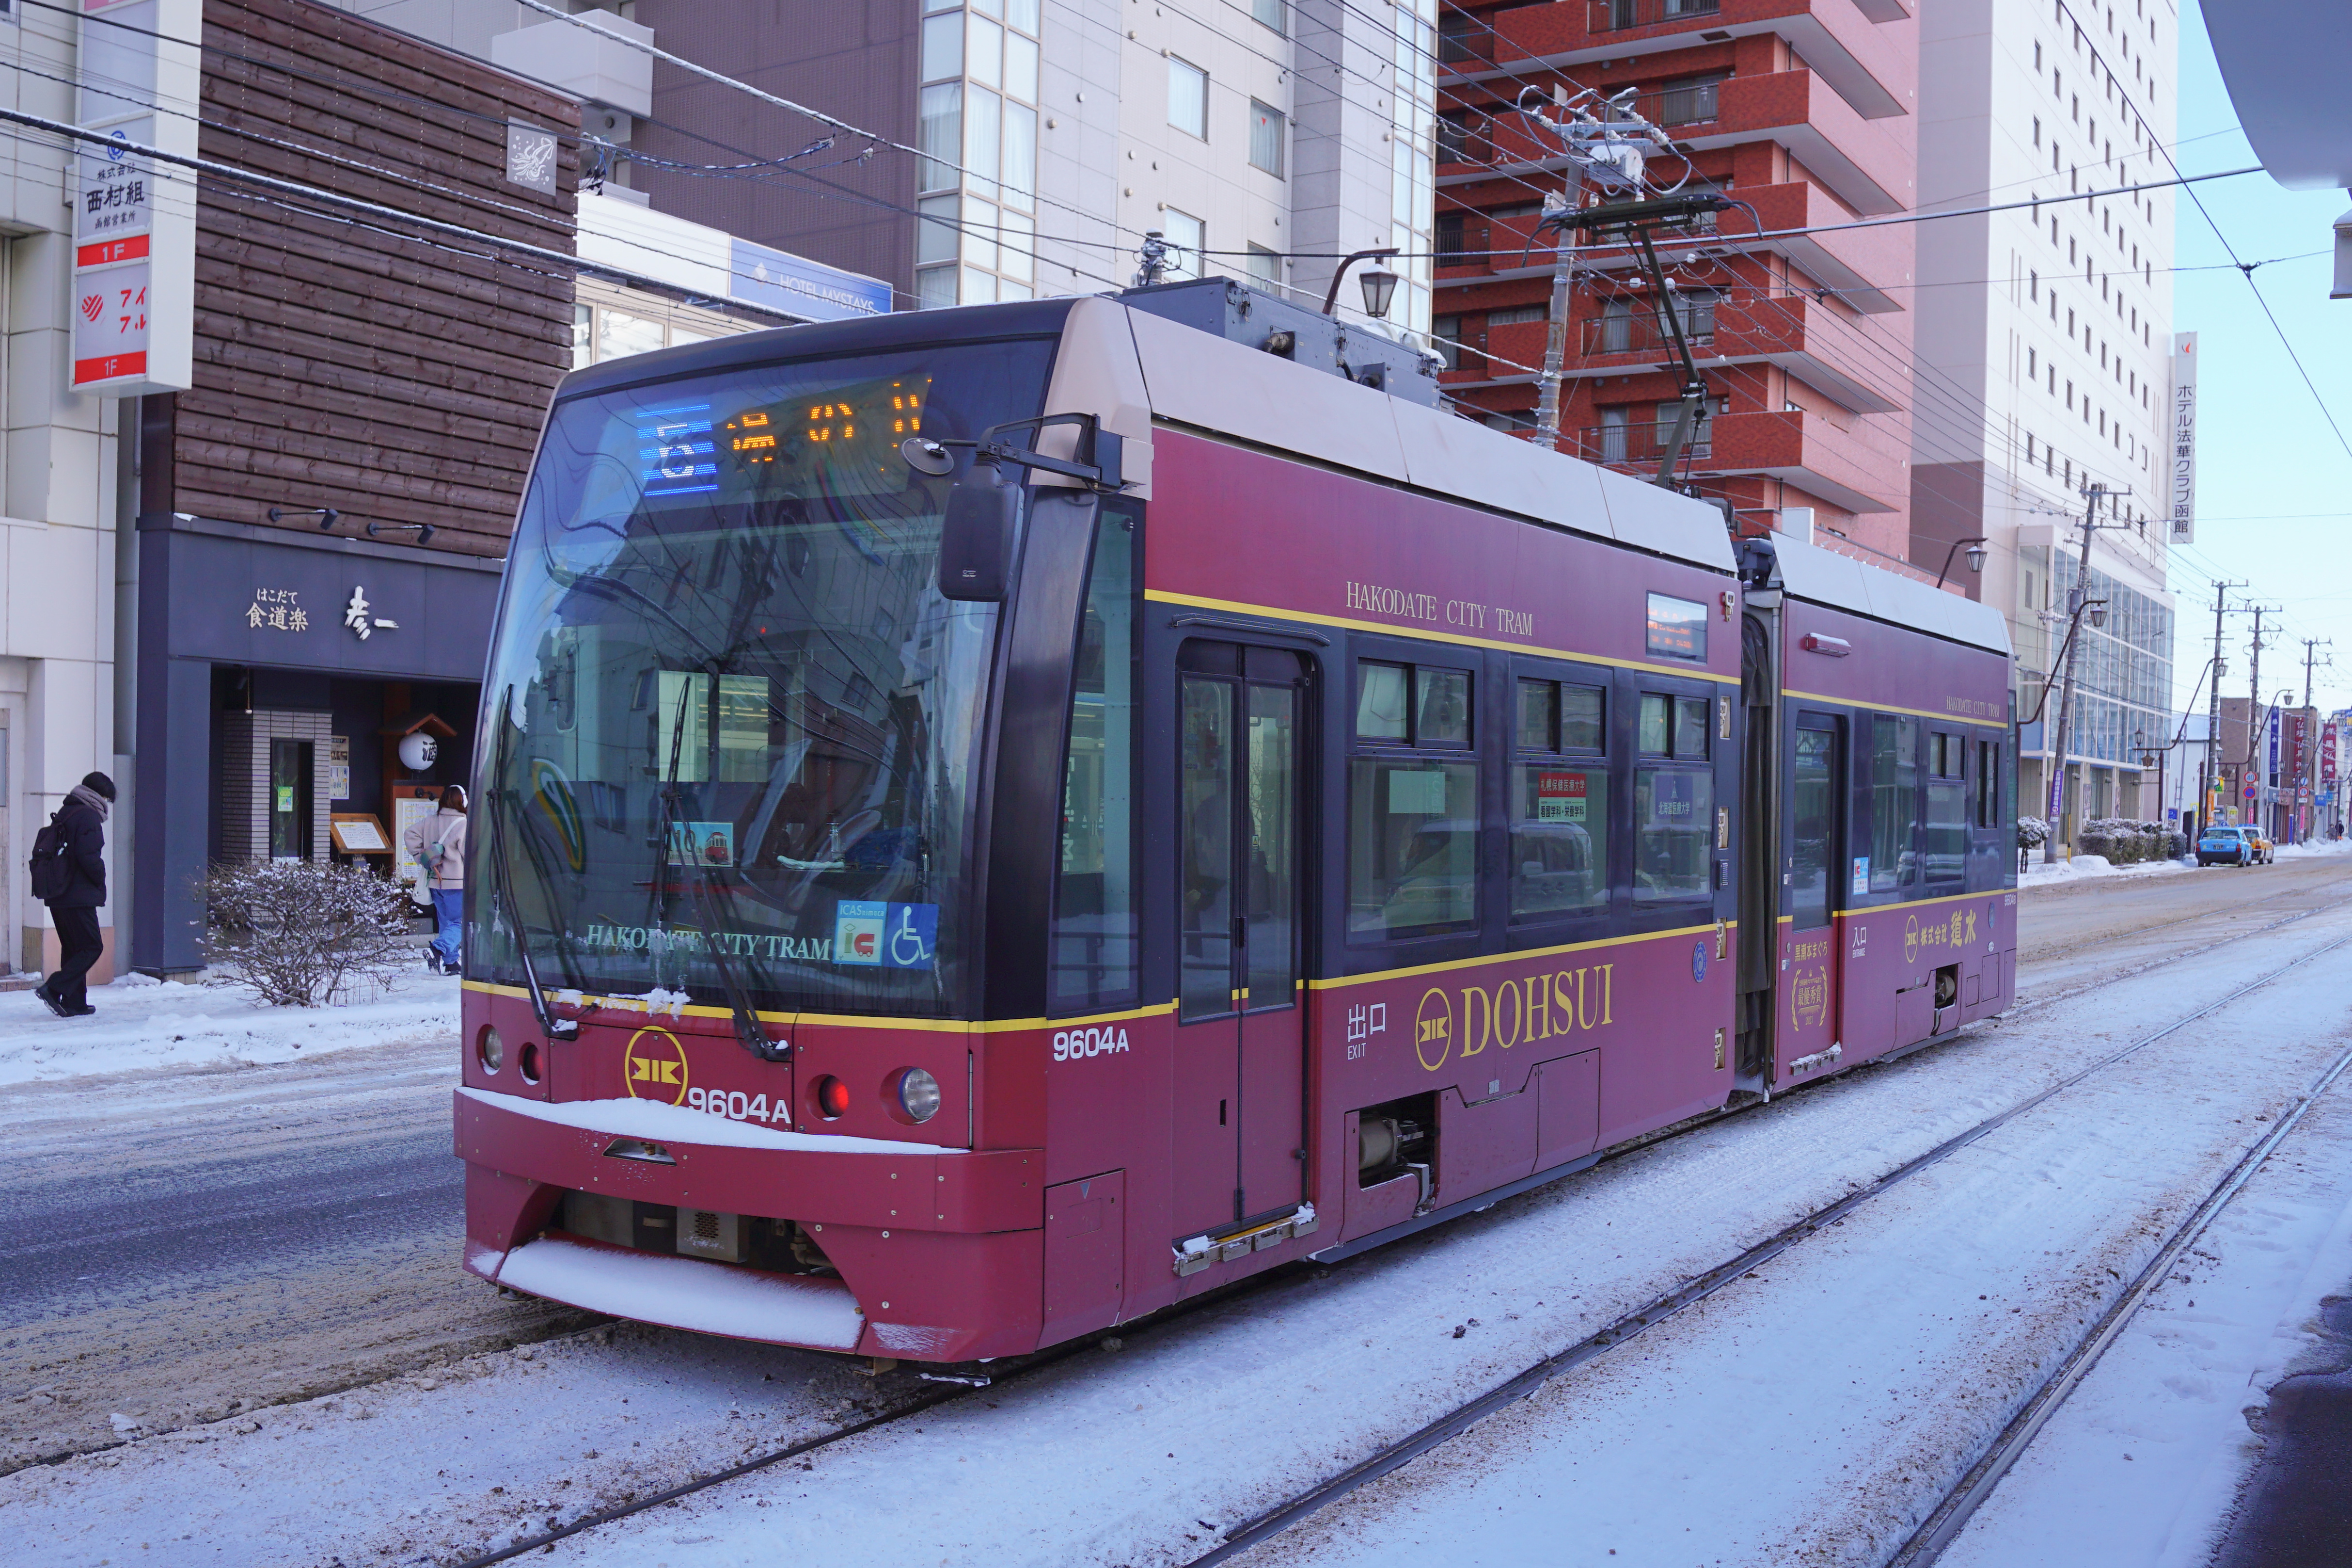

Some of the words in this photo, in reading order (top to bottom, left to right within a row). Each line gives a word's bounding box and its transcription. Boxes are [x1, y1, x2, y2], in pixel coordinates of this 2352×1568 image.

[97, 162, 136, 181] 株式会社
[86, 180, 145, 214] 西村組
[95, 210, 136, 229] 函館営業所
[102, 243, 125, 261] 1F
[121, 286, 146, 307] アイ
[779, 274, 819, 300] HOTEL
[821, 286, 875, 315] MYSTAYS
[120, 314, 146, 333] フル
[105, 359, 117, 376] 1F
[2174, 384, 2192, 533] ホテル法華クラブ函館
[257, 587, 298, 604] はこだて
[245, 602, 308, 632] 食道楽
[1346, 581, 1437, 621] HAKODATE
[1447, 600, 1487, 629] CITY
[1496, 608, 1533, 636] TRAM
[1946, 696, 1972, 713] HAKODATE
[1973, 701, 1986, 715] CITY
[1989, 703, 2000, 718] TRAM
[422, 740, 437, 762] 酒
[1541, 778, 1585, 792] 札幌保健医療大学
[1658, 801, 1690, 815] 北海道医療大学
[840, 904, 862, 916] ICAS
[1852, 926, 1867, 949] 入口
[1921, 923, 1947, 947] 株式会社
[1951, 908, 1977, 949] 道水
[765, 935, 833, 961] TRAM
[1798, 984, 1822, 1007] 最優秀賞
[1347, 1002, 1386, 1043] 出口
[1460, 964, 1613, 1058] DOHSUI
[1053, 1026, 1130, 1061] 9604A
[1347, 1043, 1367, 1061] EXIT
[688, 1087, 791, 1124] 9604A
